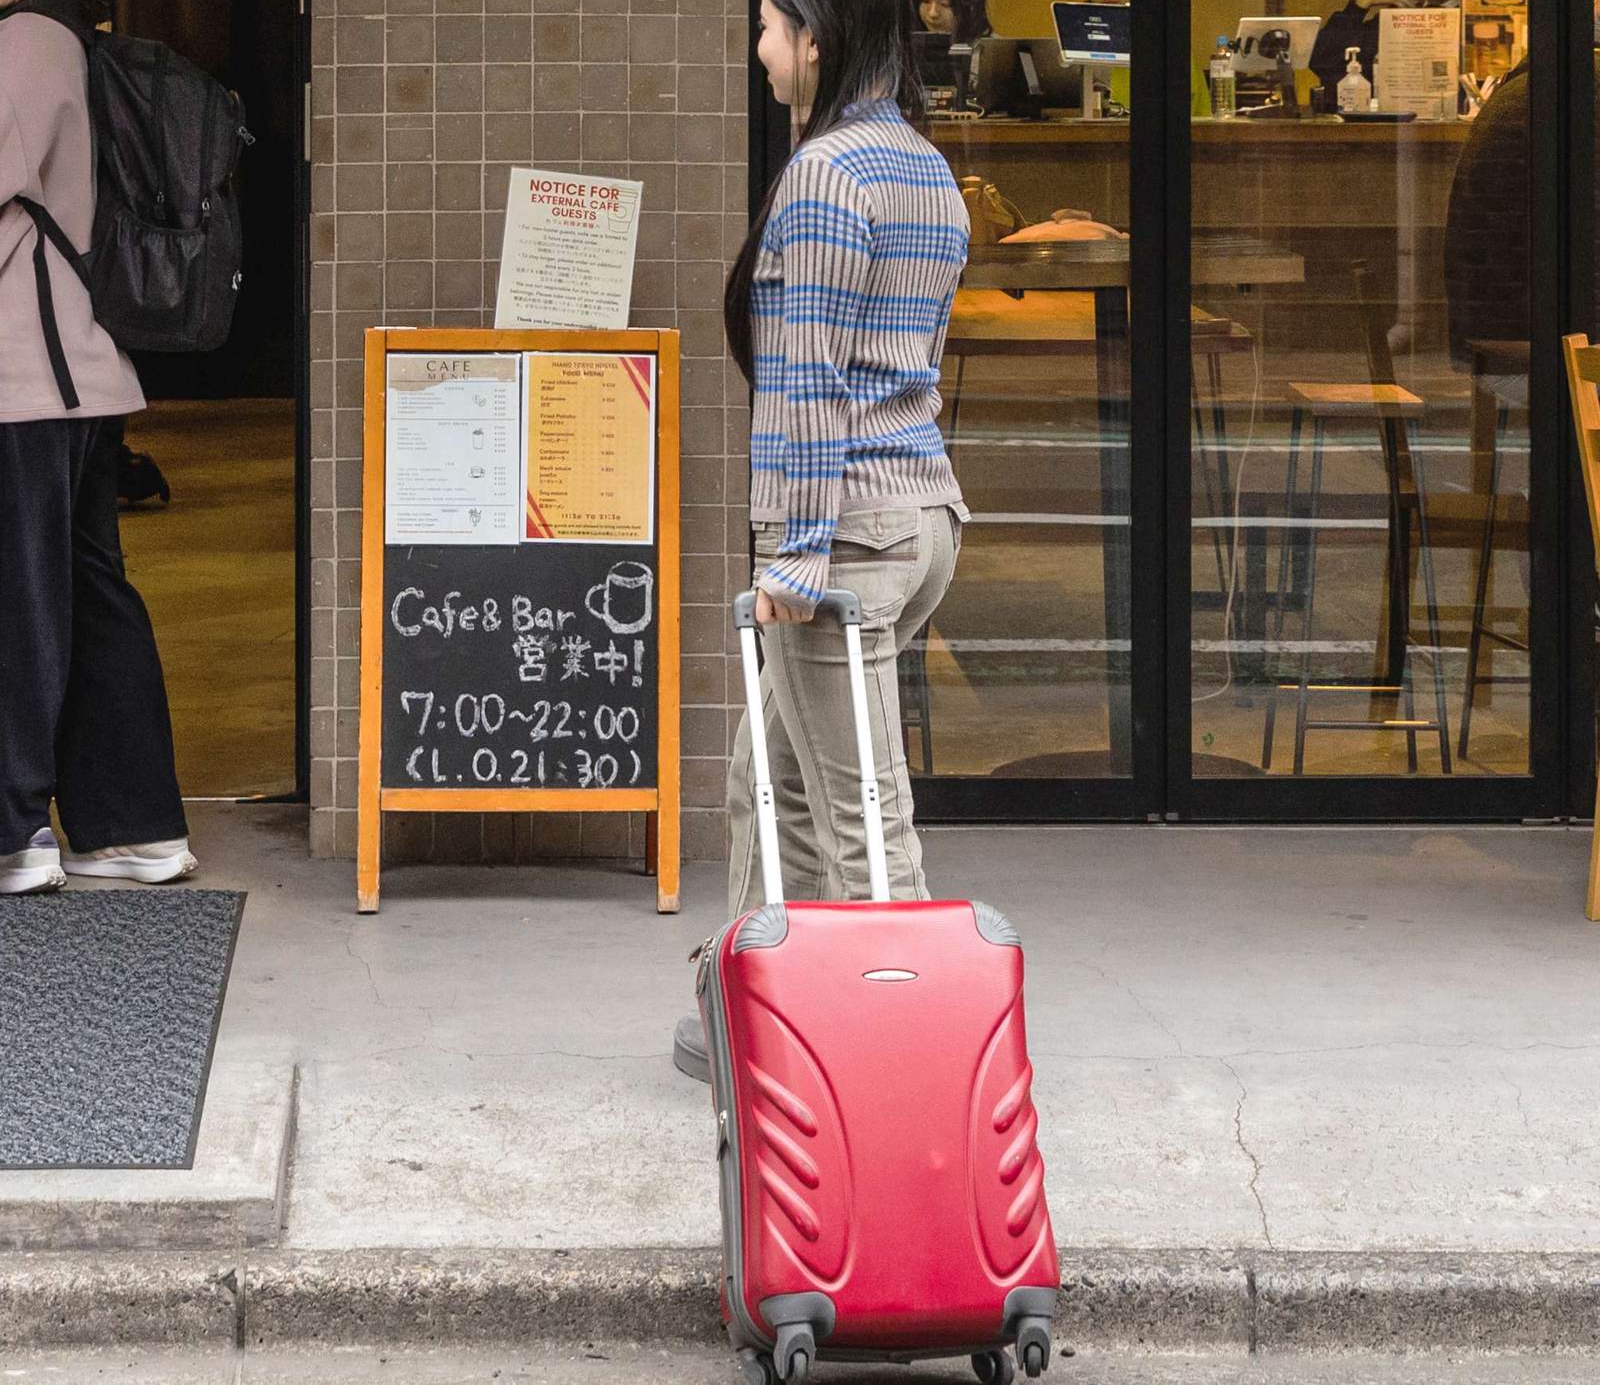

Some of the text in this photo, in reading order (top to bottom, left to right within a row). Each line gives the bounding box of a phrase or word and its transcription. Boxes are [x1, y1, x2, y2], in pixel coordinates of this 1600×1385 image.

[530, 179, 619, 200] NOTICE FOR
[531, 194, 619, 212] EXTERNAL CAFE
[551, 207, 597, 220] GUESTS
[426, 360, 471, 372] CAFE
